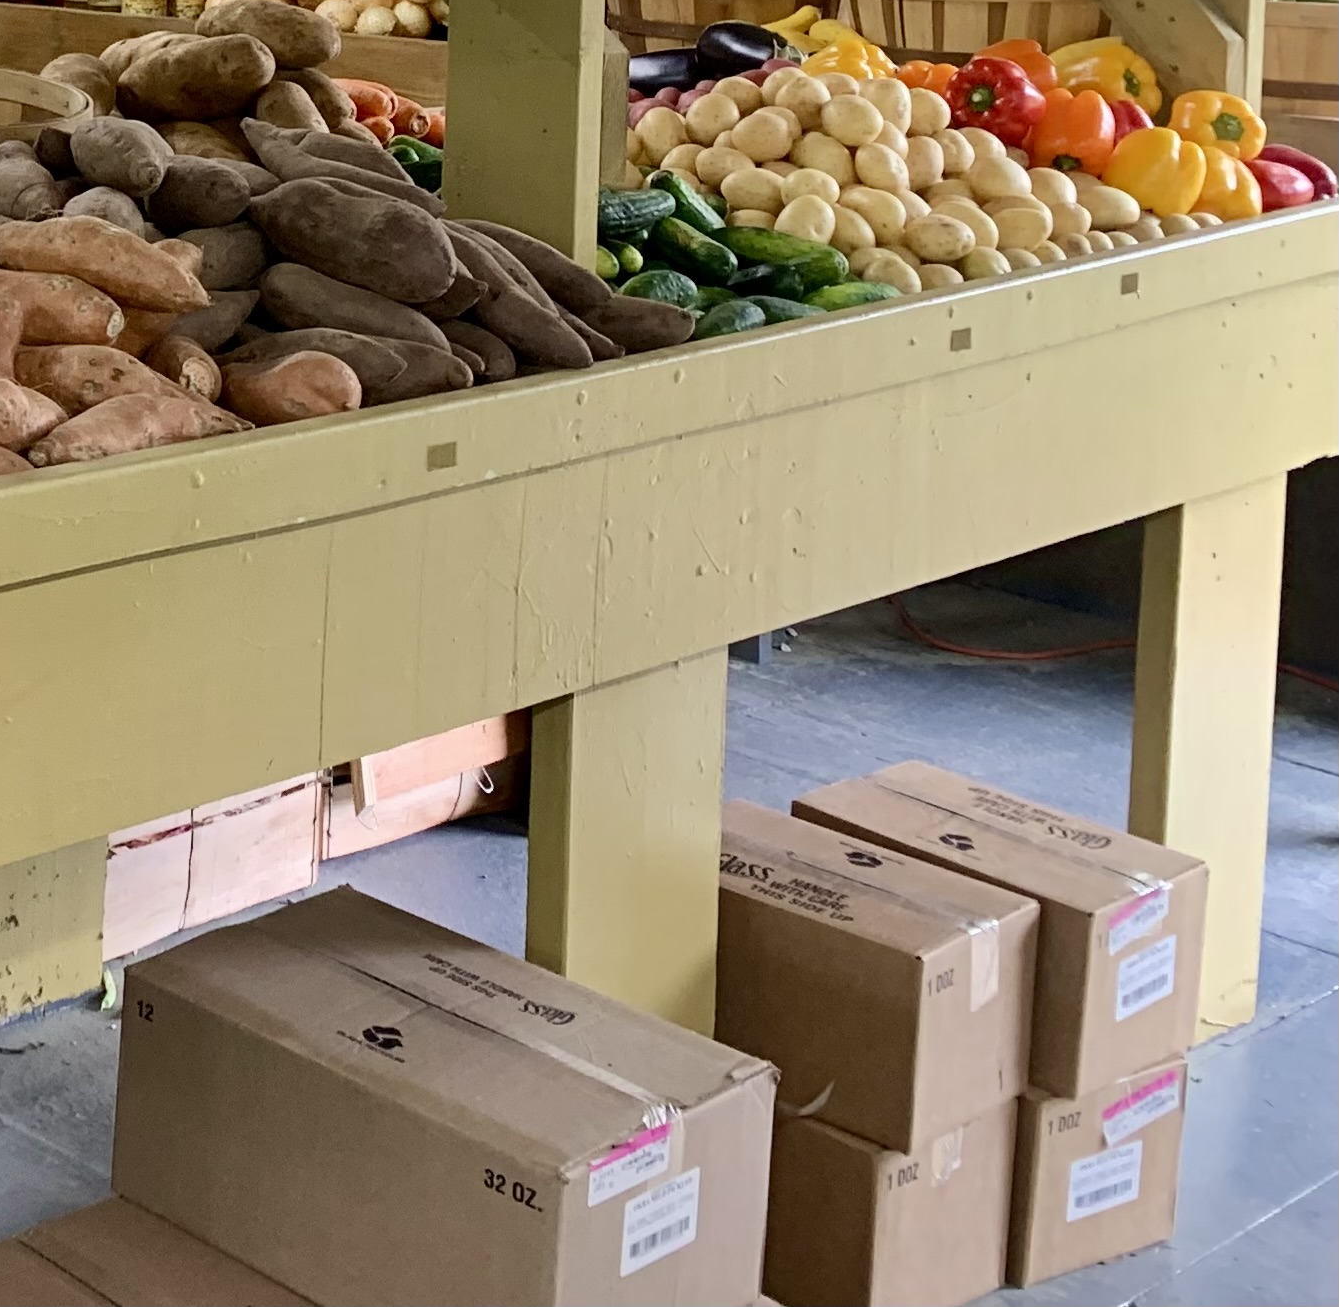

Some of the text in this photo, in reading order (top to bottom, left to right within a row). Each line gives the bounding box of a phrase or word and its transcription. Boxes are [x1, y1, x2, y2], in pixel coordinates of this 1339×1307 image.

[769, 880, 850, 911] WITH CARE
[788, 878, 850, 901] HANDLE
[750, 883, 786, 901] THIS
[829, 910, 854, 922] UP
[935, 968, 956, 990] DOZ
[135, 1000, 154, 1022] 12
[518, 1000, 579, 1025] Glass
[1048, 1111, 1082, 1135] 1 DOZ
[887, 1162, 920, 1192] 1 DOZ
[482, 1169, 544, 1213] 32 OZ.
